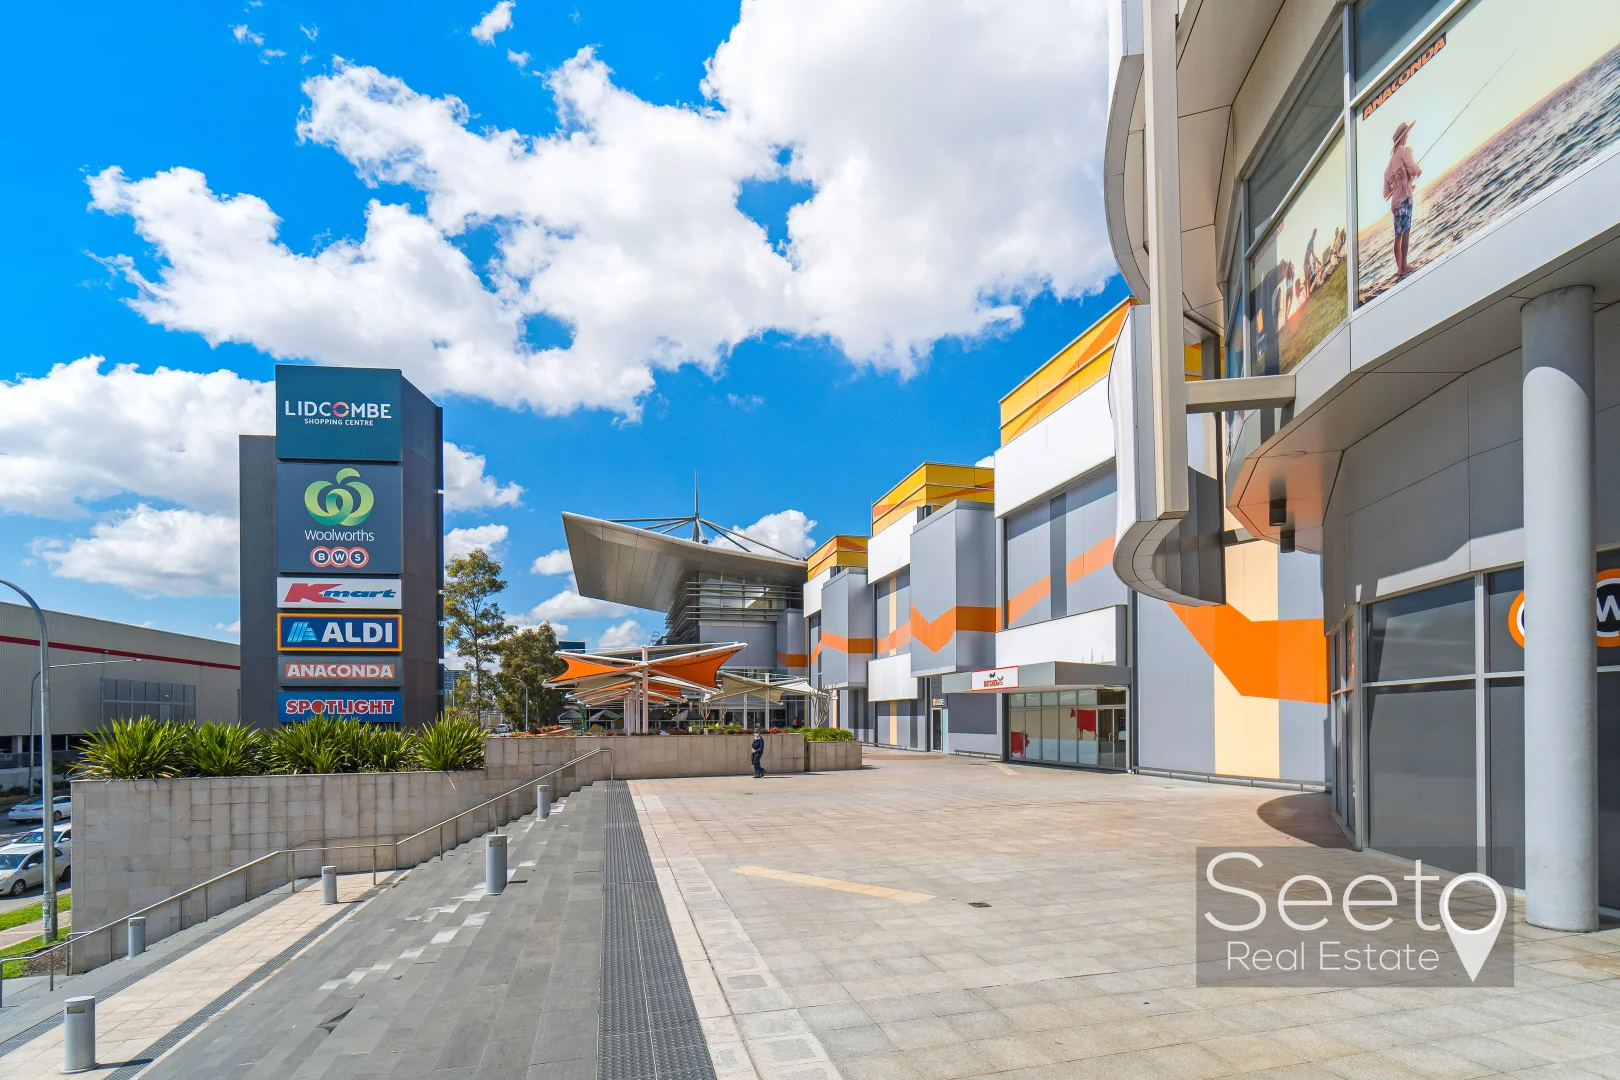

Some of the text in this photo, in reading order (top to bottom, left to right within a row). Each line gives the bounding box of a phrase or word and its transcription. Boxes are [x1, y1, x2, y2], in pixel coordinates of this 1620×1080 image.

[1363, 36, 1446, 119] ANACONDA
[285, 400, 392, 419] LIDCOMBE
[304, 528, 375, 541] Woolworths
[284, 583, 397, 604] Kmart
[321, 622, 393, 643] ALDI
[287, 664, 393, 678] ANACONDA
[285, 699, 395, 714] SPOTLIGHT
